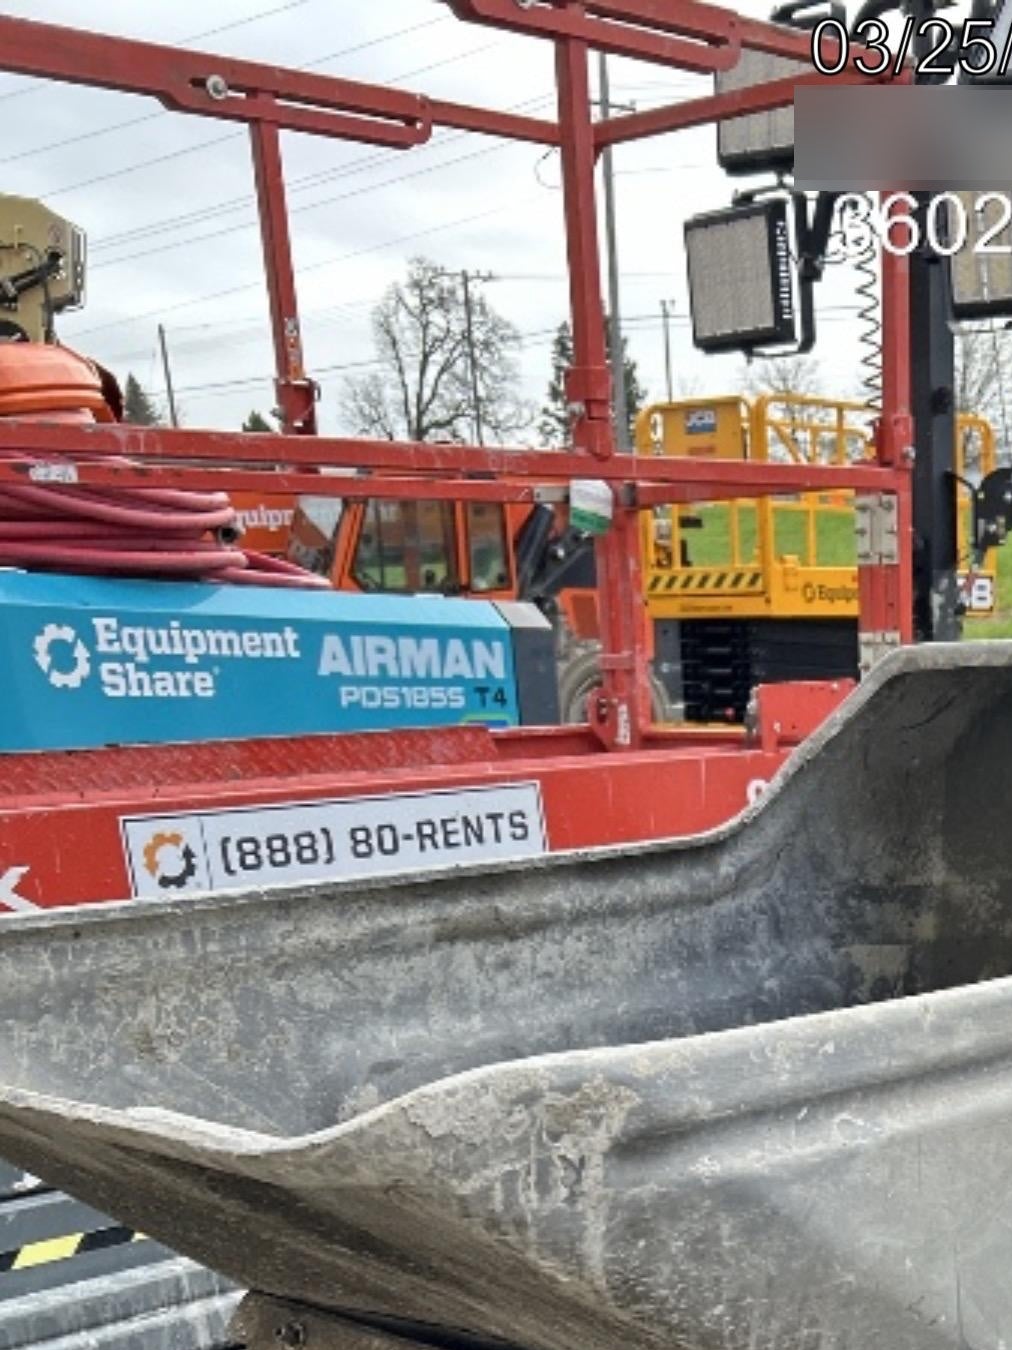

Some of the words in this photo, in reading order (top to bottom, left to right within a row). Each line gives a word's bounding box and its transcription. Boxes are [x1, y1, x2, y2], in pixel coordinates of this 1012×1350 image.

[816, 583, 859, 605] Equip
[91, 616, 301, 664] Equipment
[316, 633, 506, 680] AIRMAN
[99, 661, 217, 698] Share
[338, 685, 466, 710] PDS185S
[473, 686, 508, 708] T4
[220, 826, 335, 876] (888)
[349, 809, 530, 859] 80-RENTS
